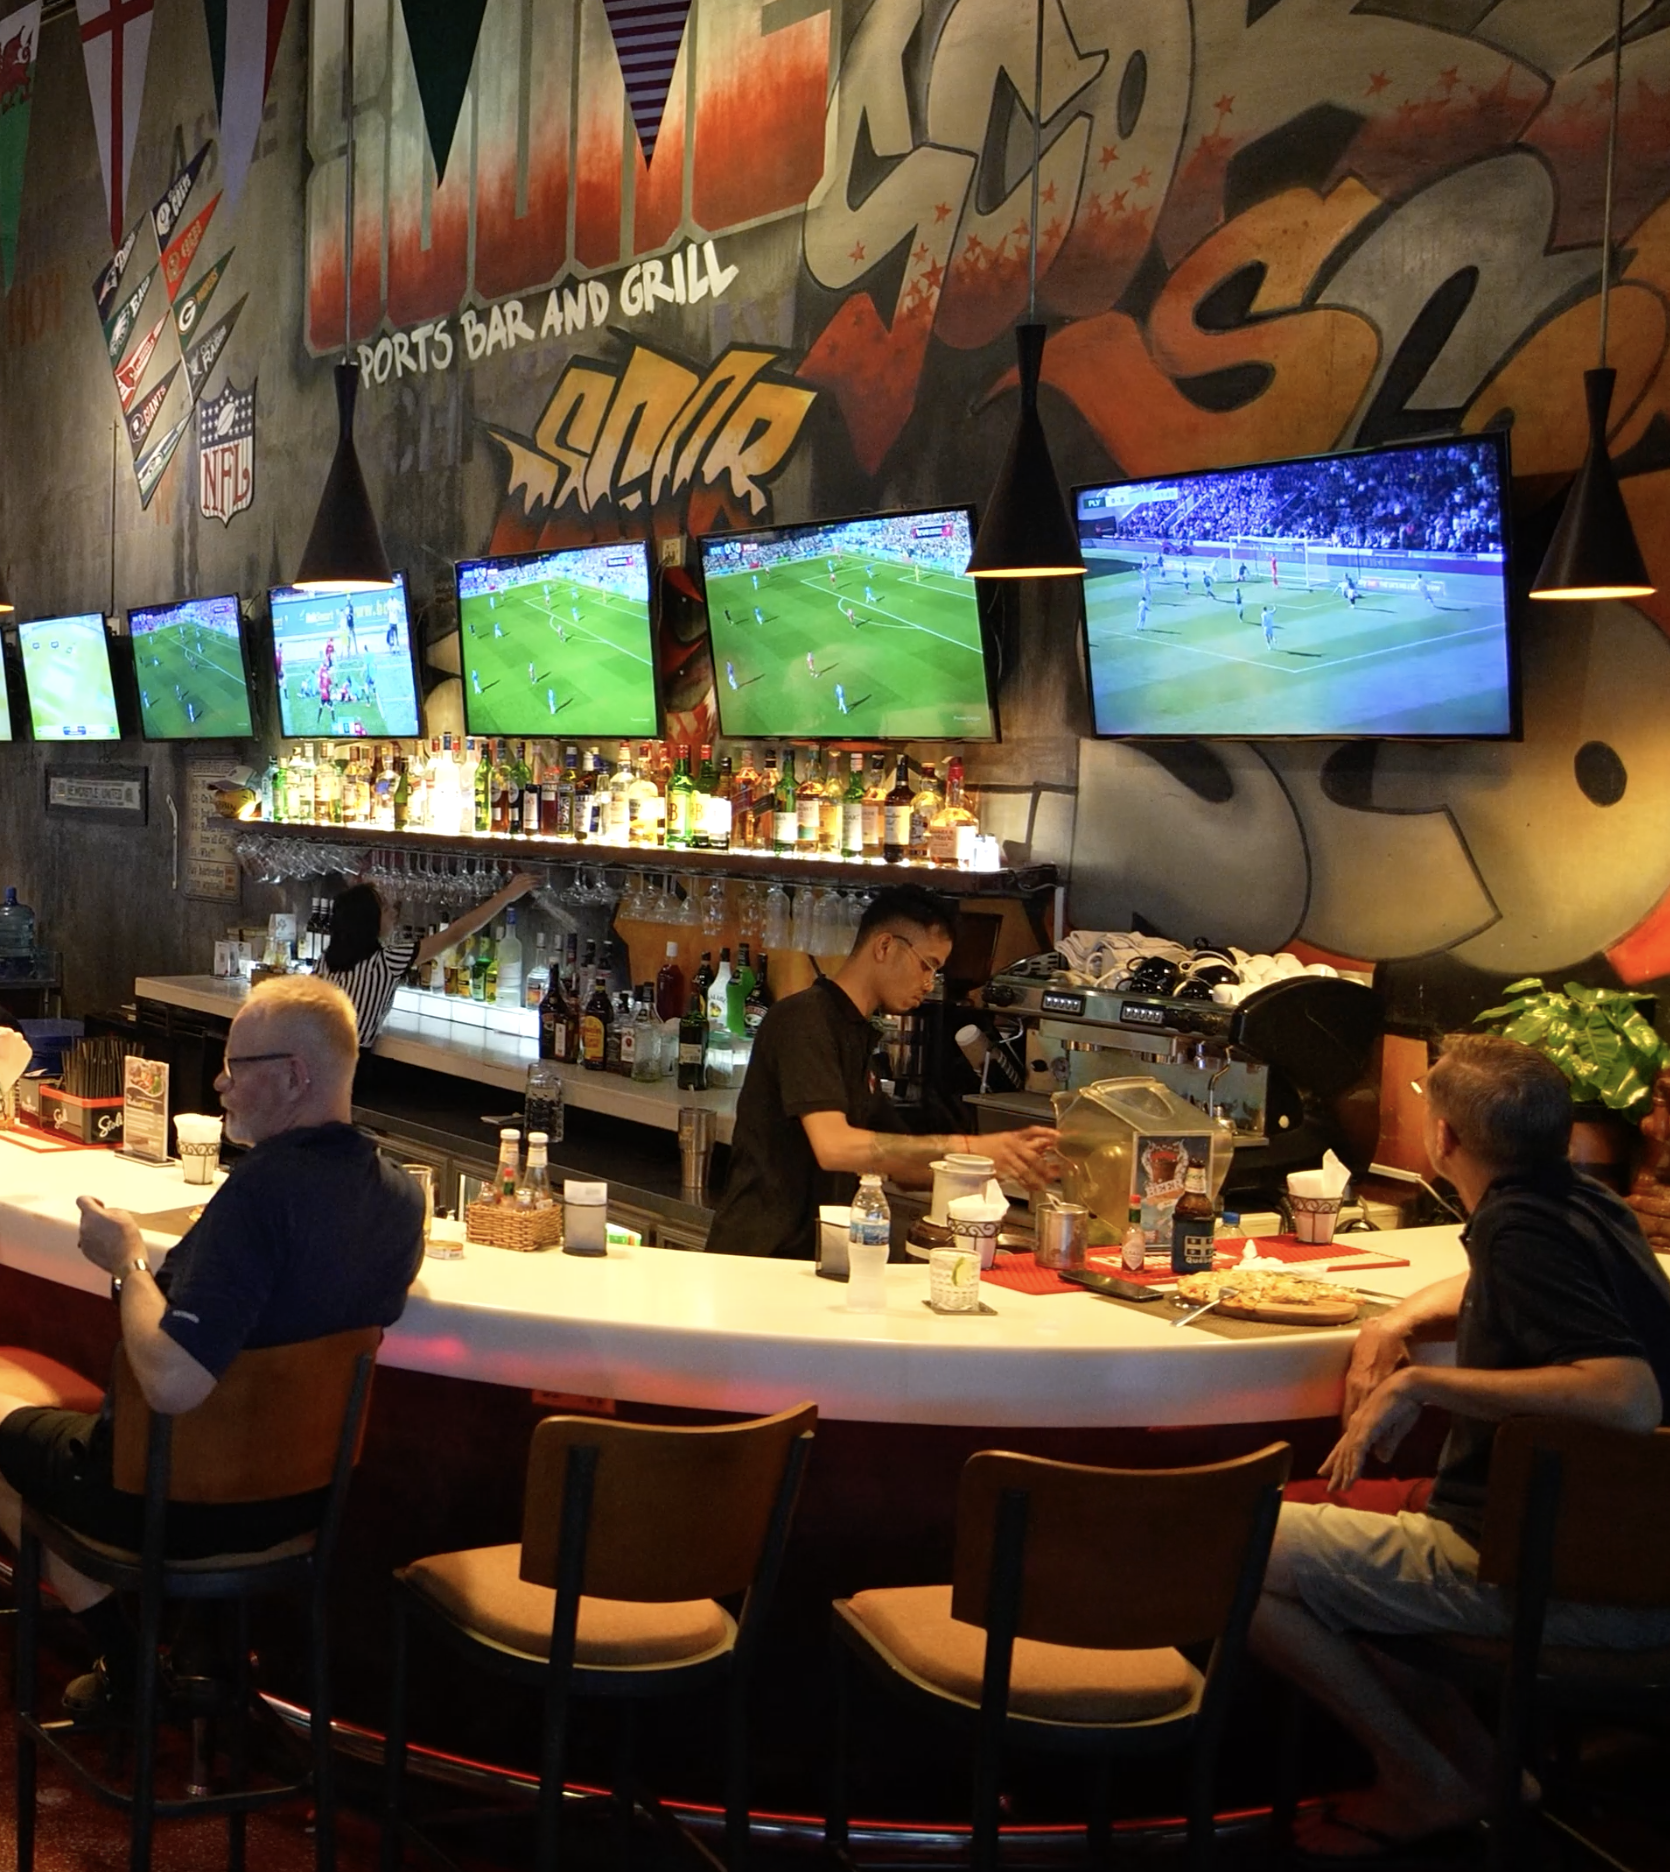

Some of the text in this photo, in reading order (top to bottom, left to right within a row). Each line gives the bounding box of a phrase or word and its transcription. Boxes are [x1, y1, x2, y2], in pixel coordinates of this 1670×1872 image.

[342, 240, 739, 389] PORTS BAR AND GRILL
[143, 384, 166, 427] GIANTS
[203, 442, 250, 517] NFL
